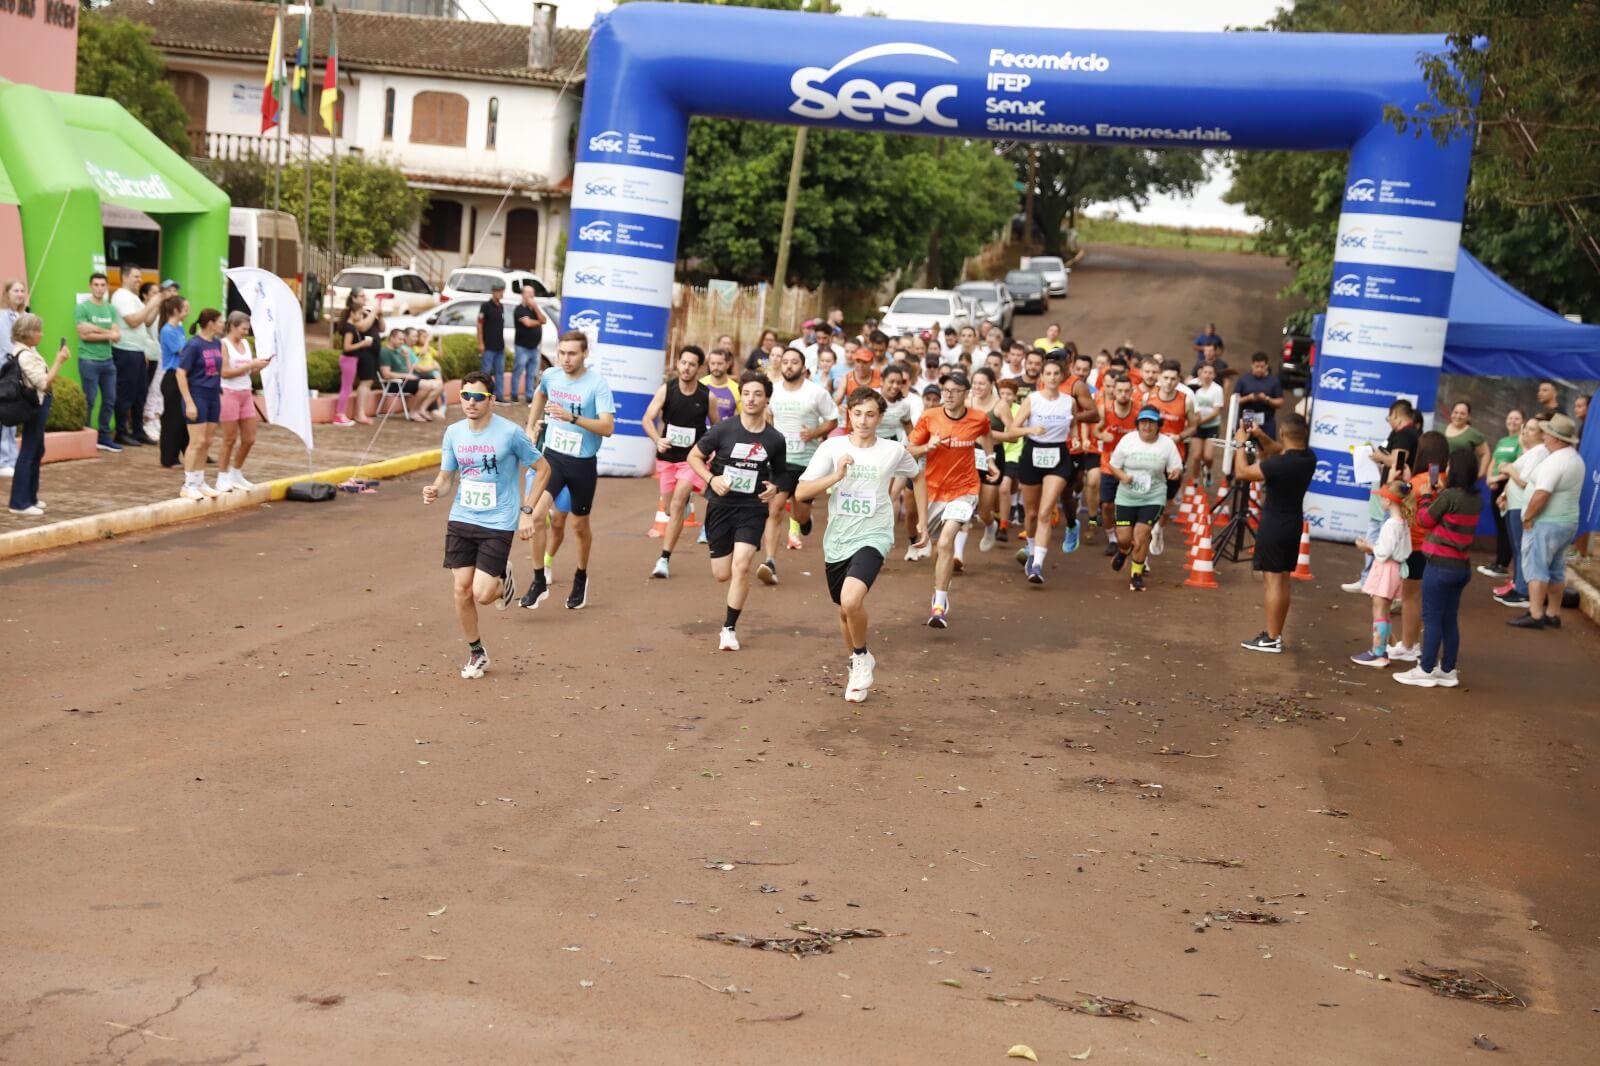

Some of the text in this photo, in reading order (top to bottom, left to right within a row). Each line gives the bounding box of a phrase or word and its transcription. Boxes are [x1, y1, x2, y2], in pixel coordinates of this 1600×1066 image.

[988, 48, 1110, 72] Fecomércio
[788, 42, 959, 128] Sesc
[986, 72, 1031, 92] IFEP
[985, 97, 1047, 116] Senac
[986, 118, 1232, 142] Sindicatos Empresariais
[589, 131, 623, 153] Sesc
[105, 169, 173, 200] Sicredi
[584, 181, 617, 197] Sesc
[579, 220, 612, 243] Sesc
[575, 271, 606, 286] Sesc
[554, 436, 577, 453] 517
[670, 433, 691, 446] 230
[457, 445, 496, 454] CHAPADA
[1035, 455, 1056, 466] 267
[464, 490, 491, 507] 375
[841, 499, 871, 515] 465
